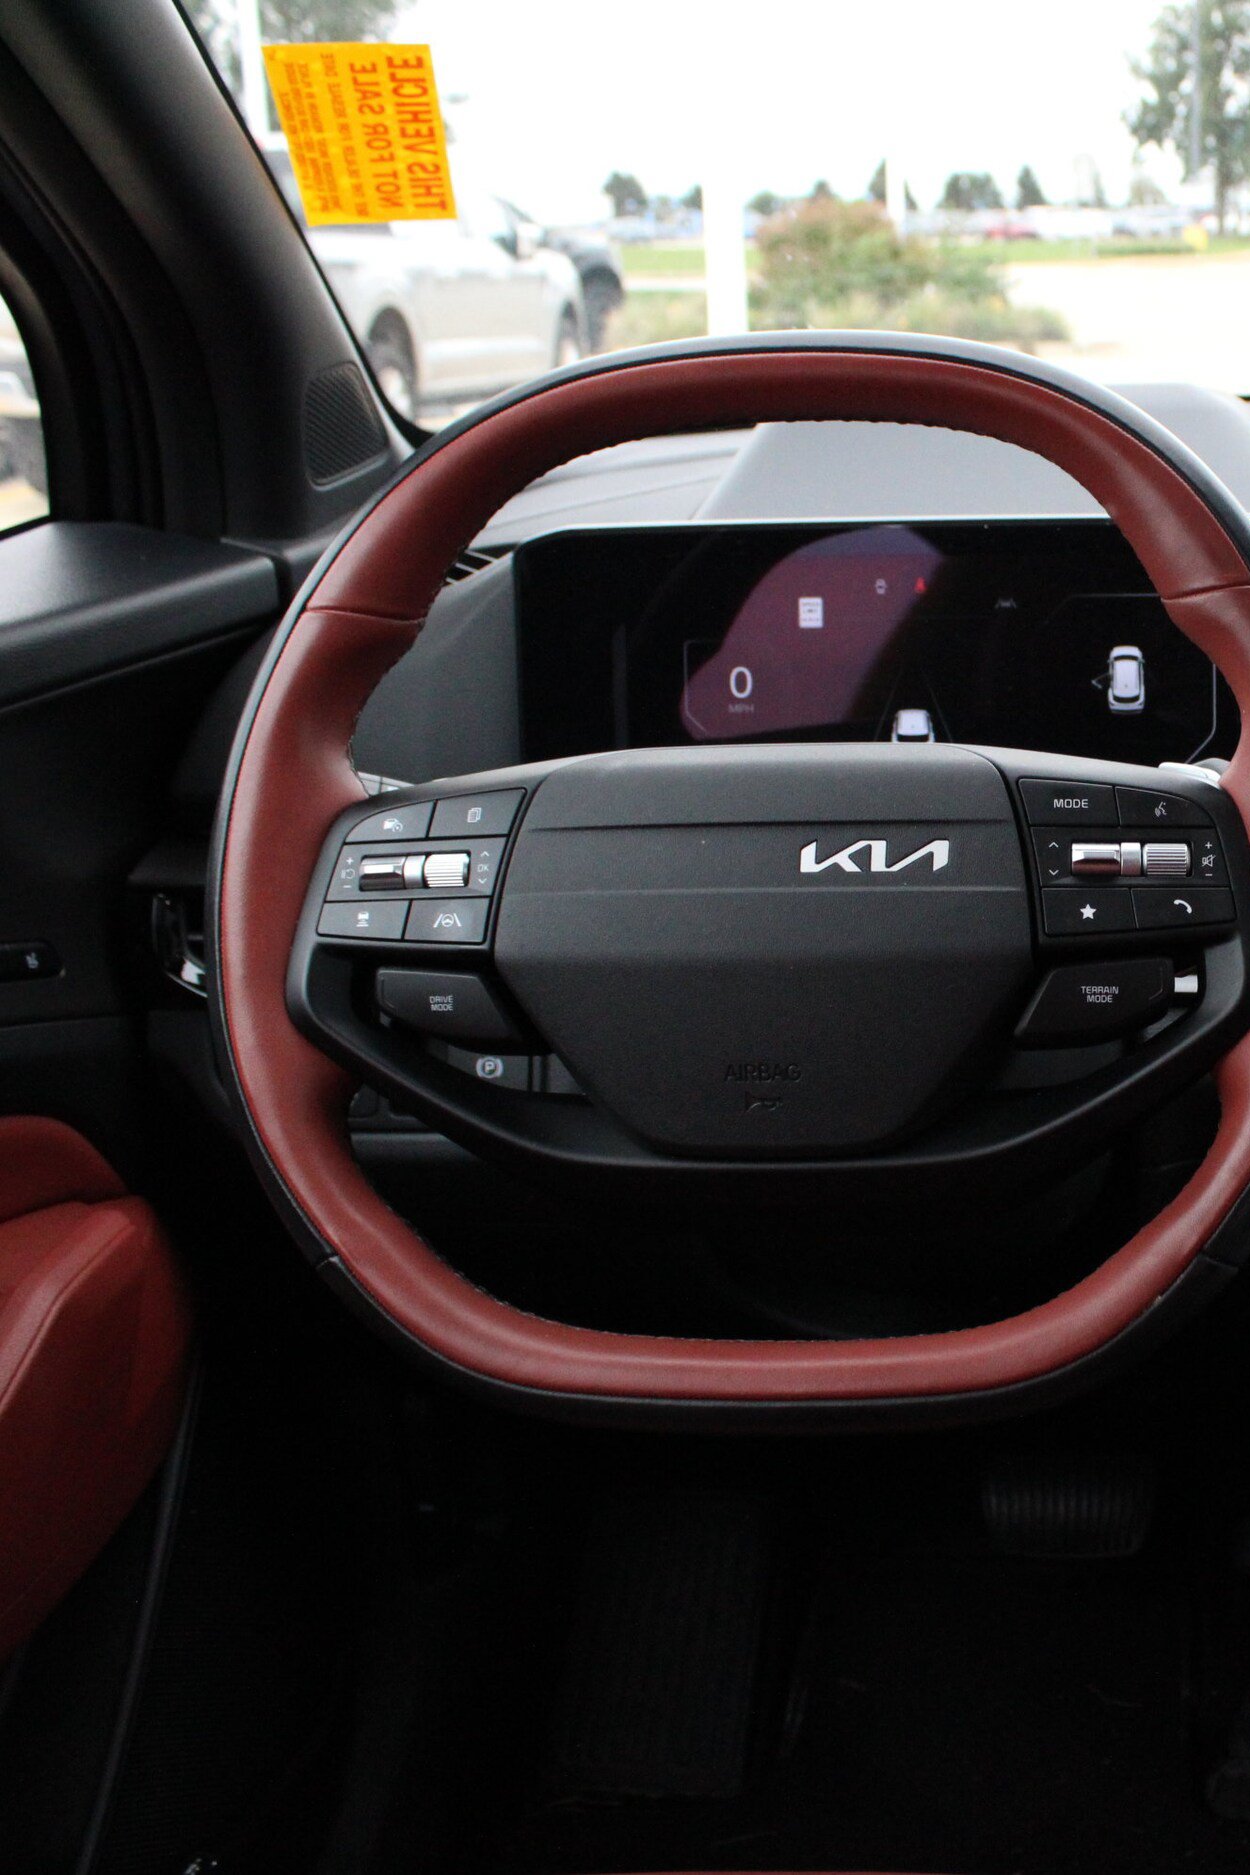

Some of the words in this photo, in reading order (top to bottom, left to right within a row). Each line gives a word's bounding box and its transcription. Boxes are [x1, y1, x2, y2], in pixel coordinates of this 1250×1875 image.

[729, 665, 753, 698] 0
[1053, 799, 1089, 809] MODE
[800, 839, 950, 873] KIA
[1080, 985, 1119, 995] TERRAIN
[429, 995, 454, 1004] DRIVE
[1086, 994, 1113, 1003] MODE
[431, 1002, 454, 1011] MODE
[723, 1063, 802, 1082] AIRBAG
